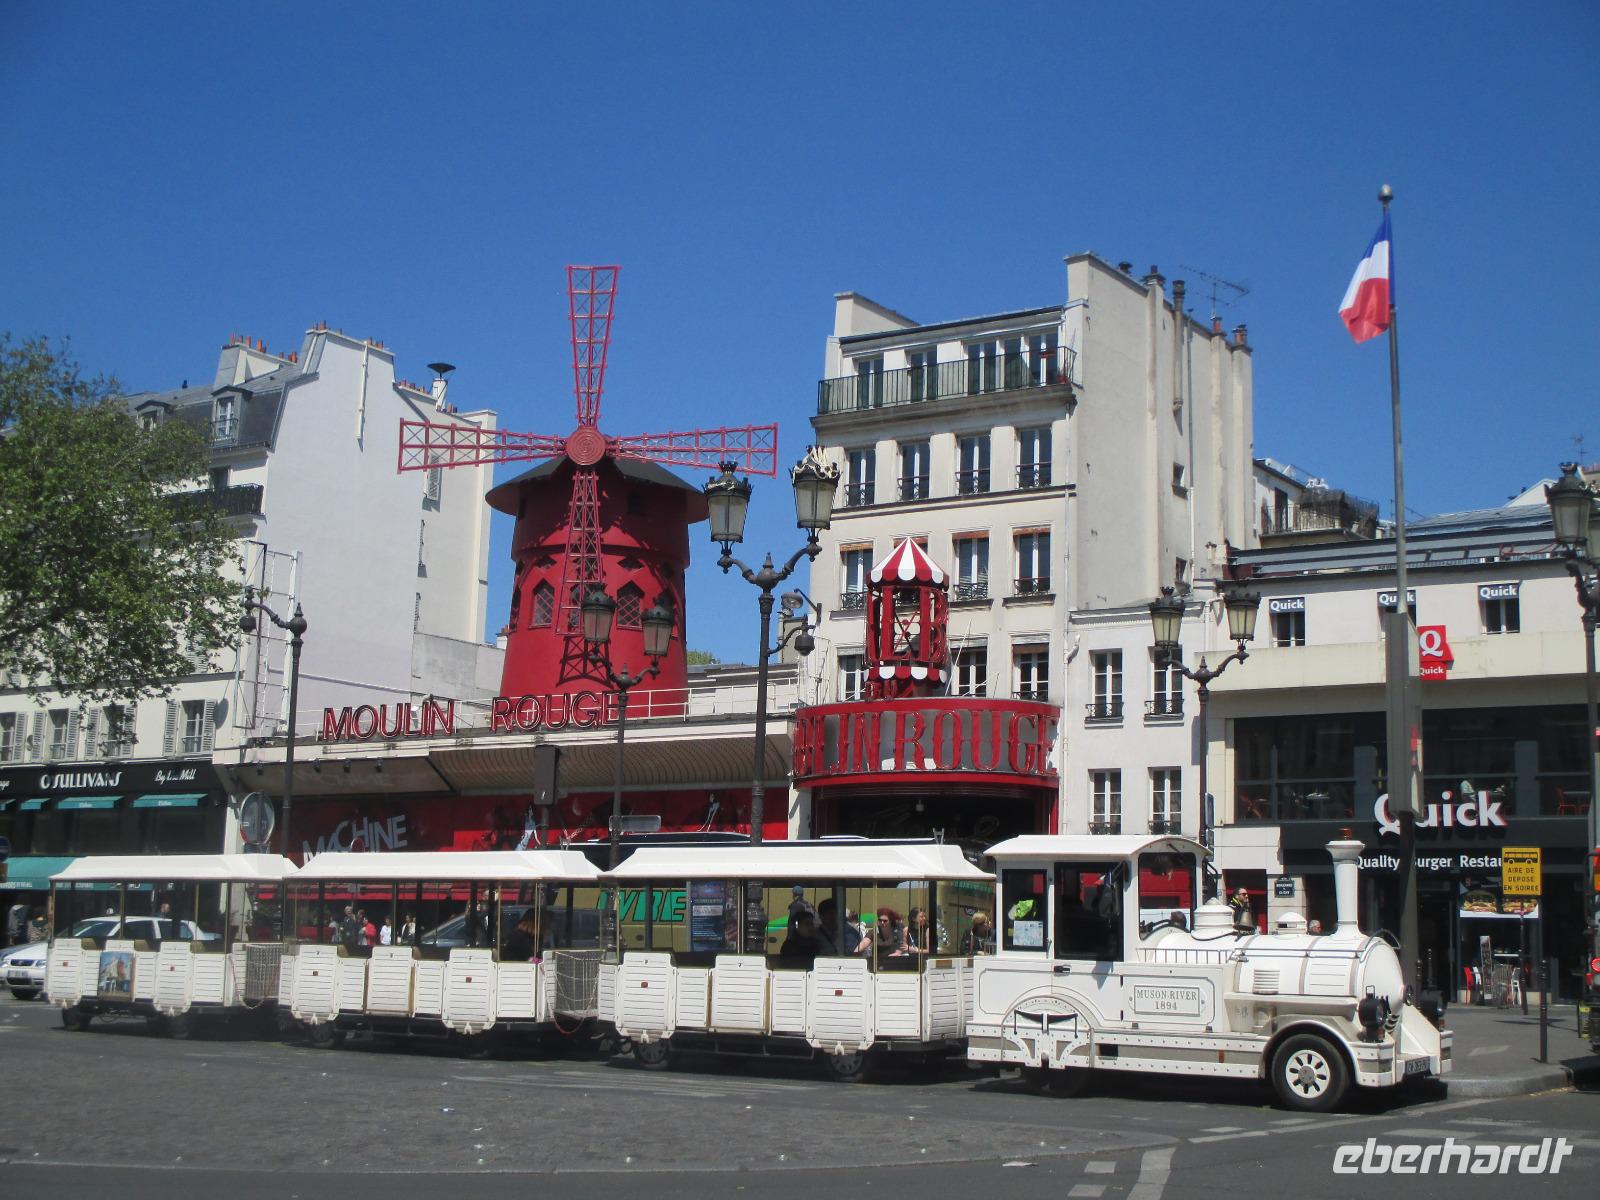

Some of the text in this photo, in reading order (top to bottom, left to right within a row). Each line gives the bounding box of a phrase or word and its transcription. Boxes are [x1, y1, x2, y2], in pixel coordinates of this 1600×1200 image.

[1480, 584, 1518, 598] Quick
[1379, 592, 1415, 605] Quk
[1270, 600, 1304, 612] Quick
[1419, 630, 1444, 657] Q
[1419, 667, 1444, 677] Quick
[322, 690, 622, 742] MOULIN ROUGE
[894, 708, 1060, 776] ROUGE
[302, 814, 408, 865] MACHINE
[1413, 856, 1453, 870] urger
[1155, 1001, 1178, 1010] 1894
